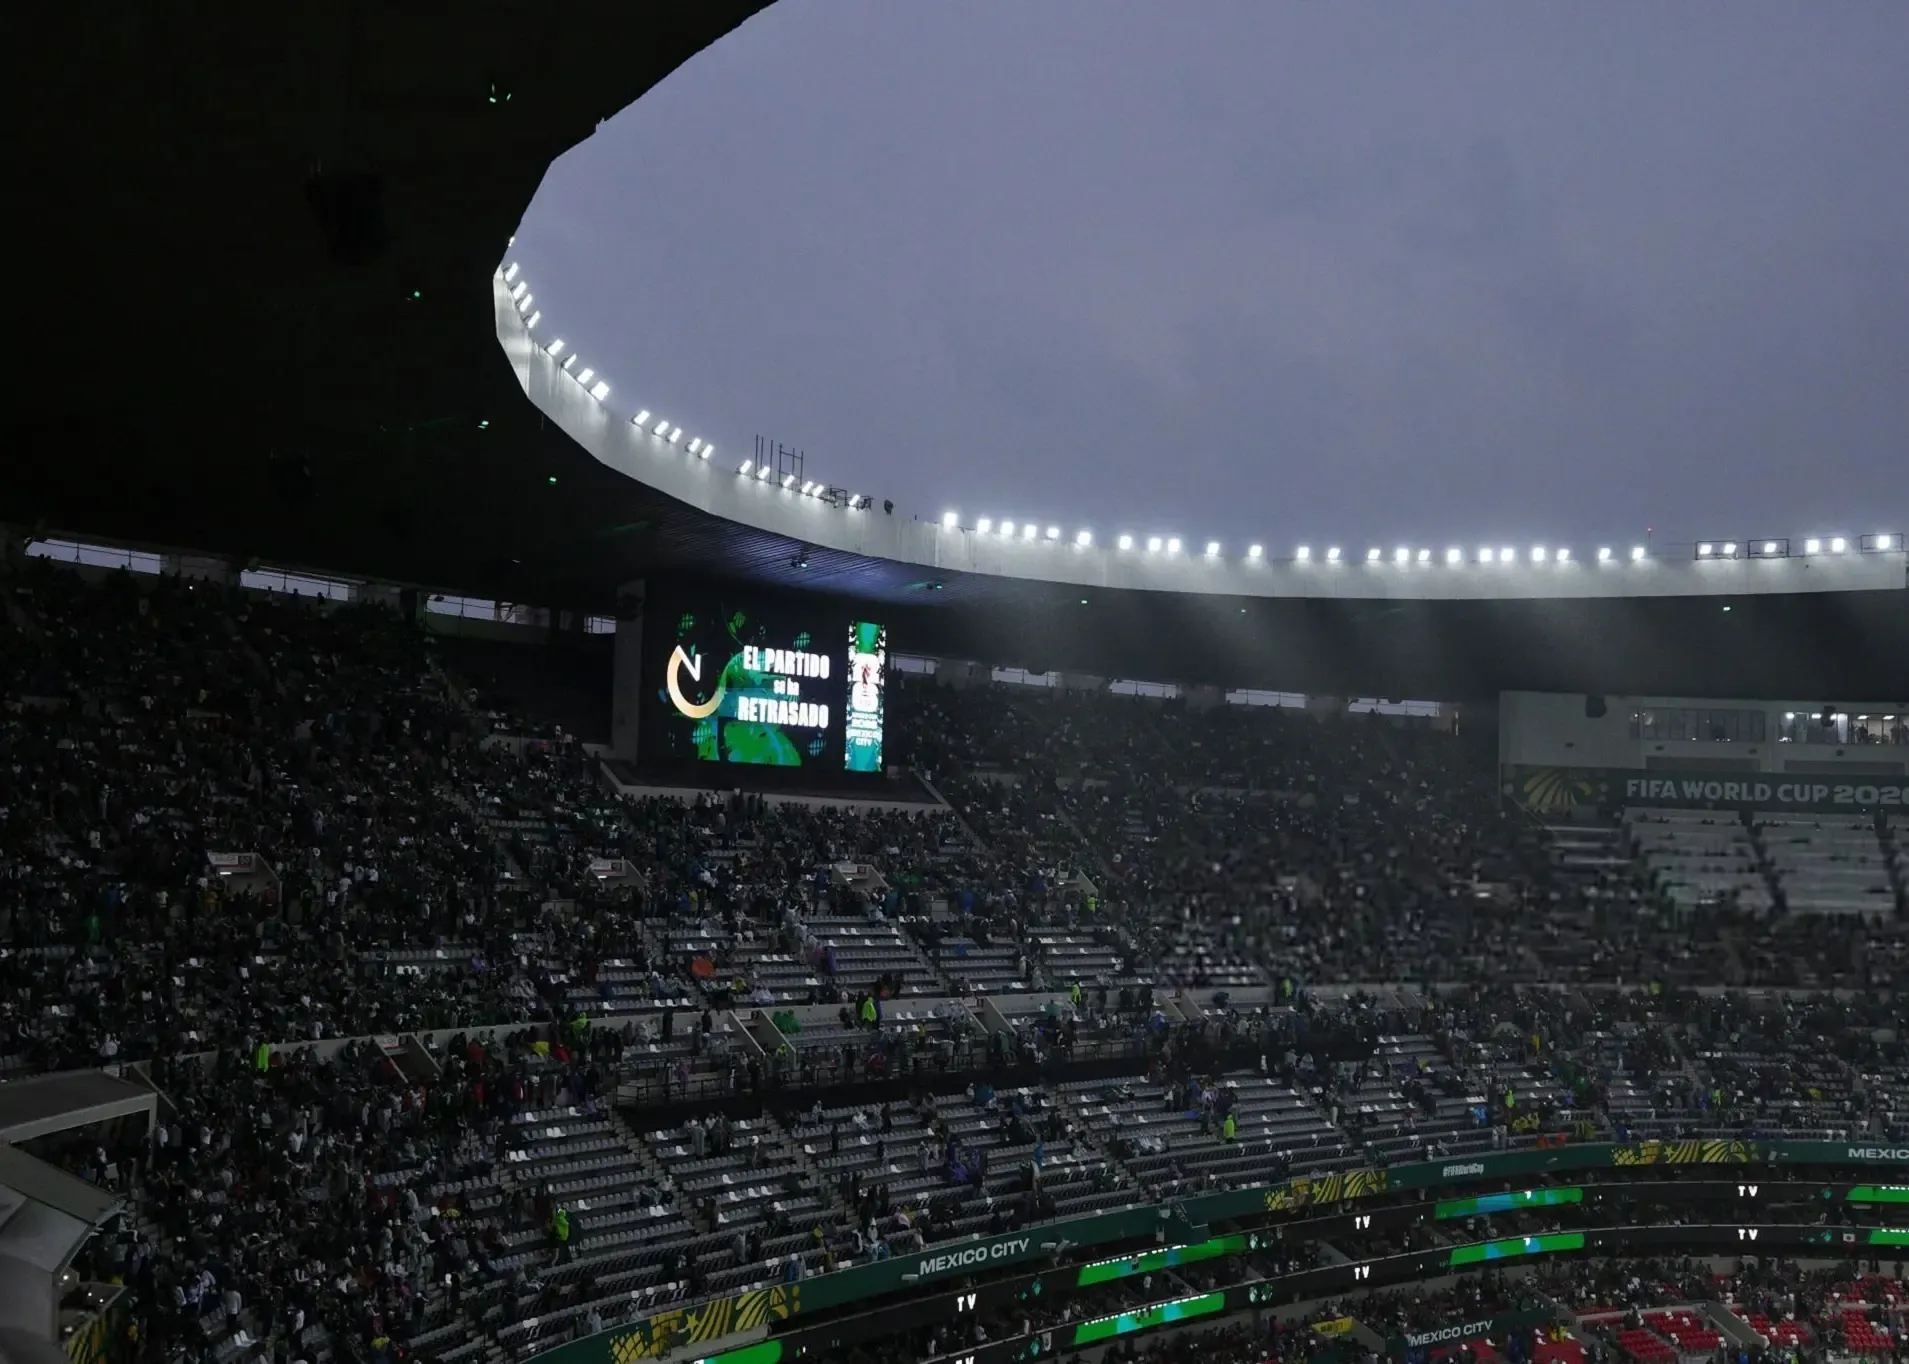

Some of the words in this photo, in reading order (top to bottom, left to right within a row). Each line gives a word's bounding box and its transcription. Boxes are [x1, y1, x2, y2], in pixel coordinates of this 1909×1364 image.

[743, 645, 761, 671] EL
[764, 648, 830, 679] PARTIDO
[738, 696, 829, 728] RETRASADO
[1626, 779, 1678, 799] FIFA
[1682, 780, 1771, 801] WORLD
[1777, 783, 1829, 803] CUP
[919, 1247, 988, 1276] MEXICO
[991, 1238, 1030, 1258] CITY
[1409, 1326, 1461, 1347] MEXICO
[1463, 1320, 1493, 1336] CITY
